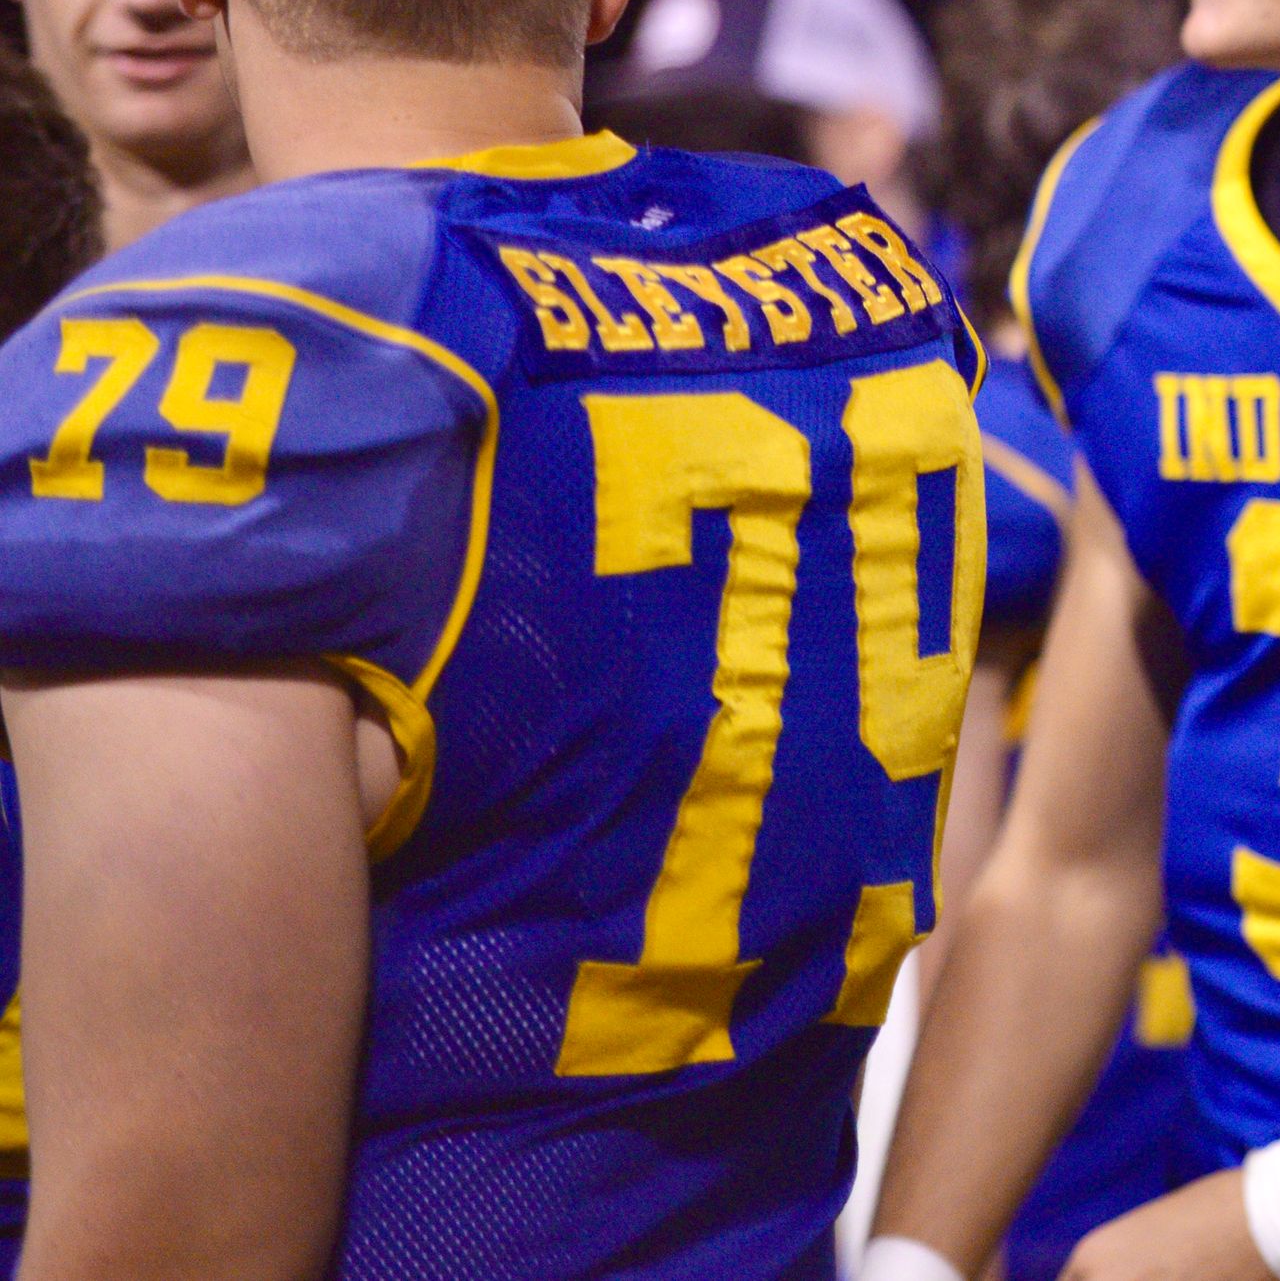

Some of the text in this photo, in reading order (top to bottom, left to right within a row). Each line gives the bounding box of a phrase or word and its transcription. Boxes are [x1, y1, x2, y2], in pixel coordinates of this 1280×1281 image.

[498, 212, 942, 352] SLEYSTER
[28, 316, 297, 506] 79
[554, 360, 987, 1078] 79
